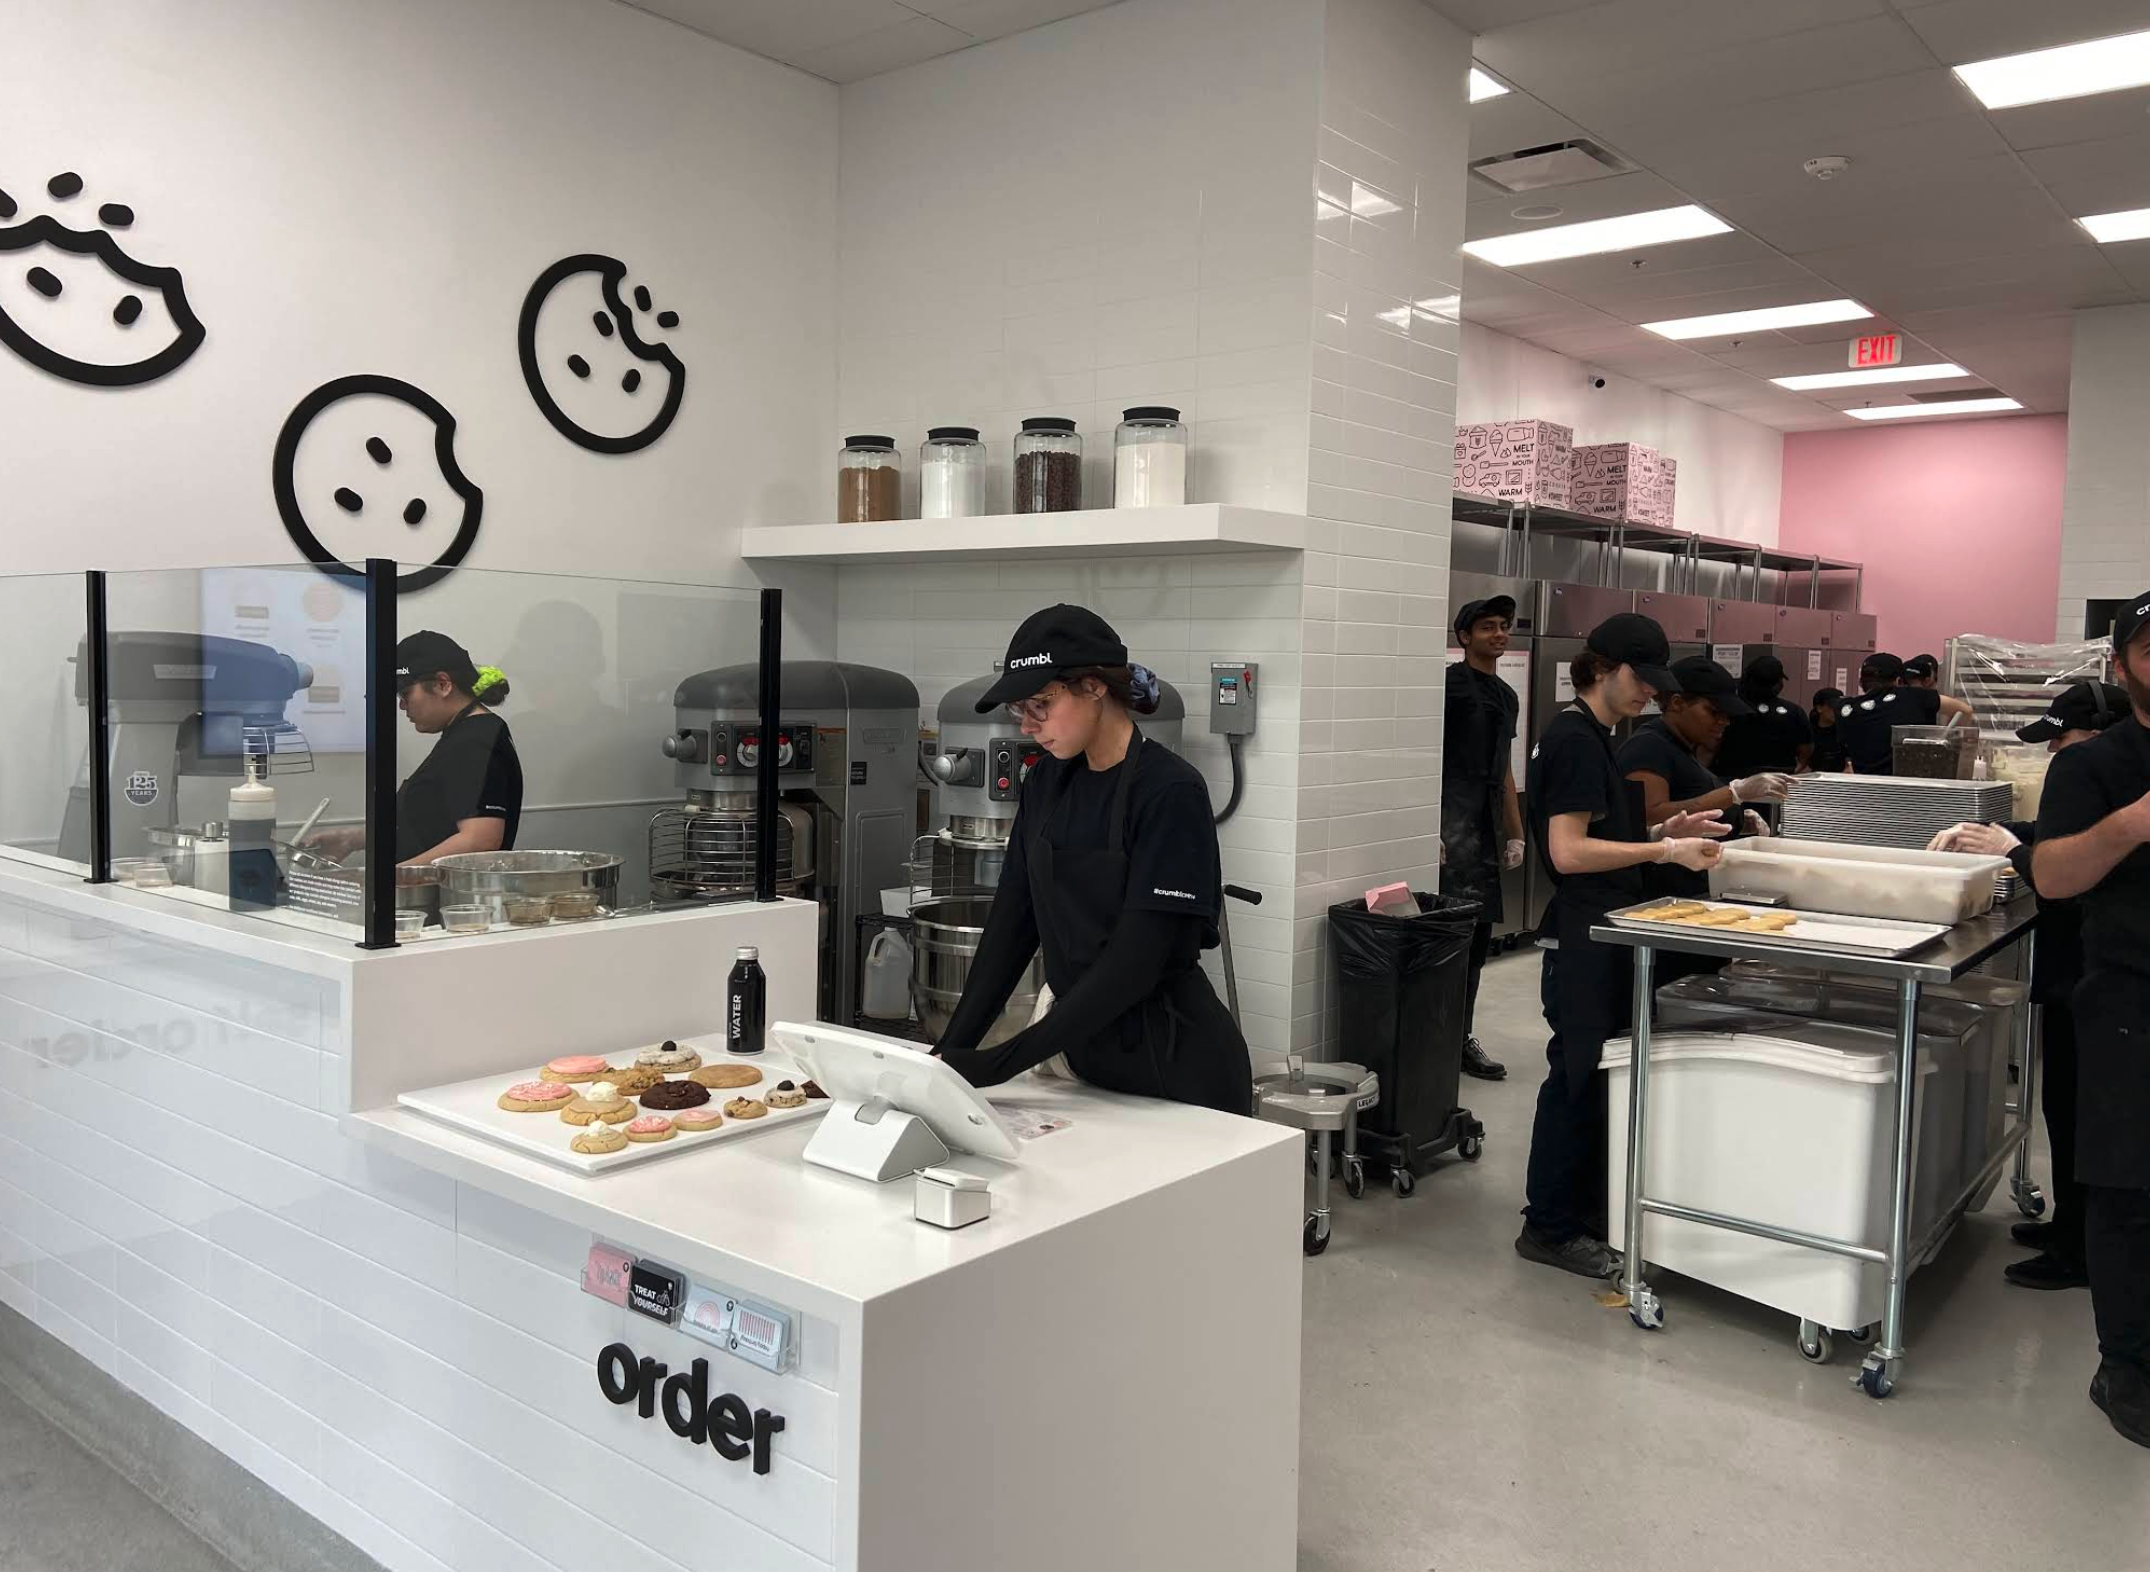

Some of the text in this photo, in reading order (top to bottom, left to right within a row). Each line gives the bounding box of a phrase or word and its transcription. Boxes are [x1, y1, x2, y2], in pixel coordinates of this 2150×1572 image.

[1858, 335, 1895, 364] EXIT
[1513, 443, 1535, 453] MELT
[1606, 465, 1627, 474] MELT
[1498, 488, 1523, 496] WARM
[1593, 505, 1617, 513] WARM
[1010, 652, 1053, 669] crumbl
[127, 775, 157, 789] 125
[732, 994, 742, 1039] WATER
[634, 1284, 657, 1300] TREAT
[633, 1297, 669, 1316] YOURSELF
[597, 1342, 785, 1476] order
